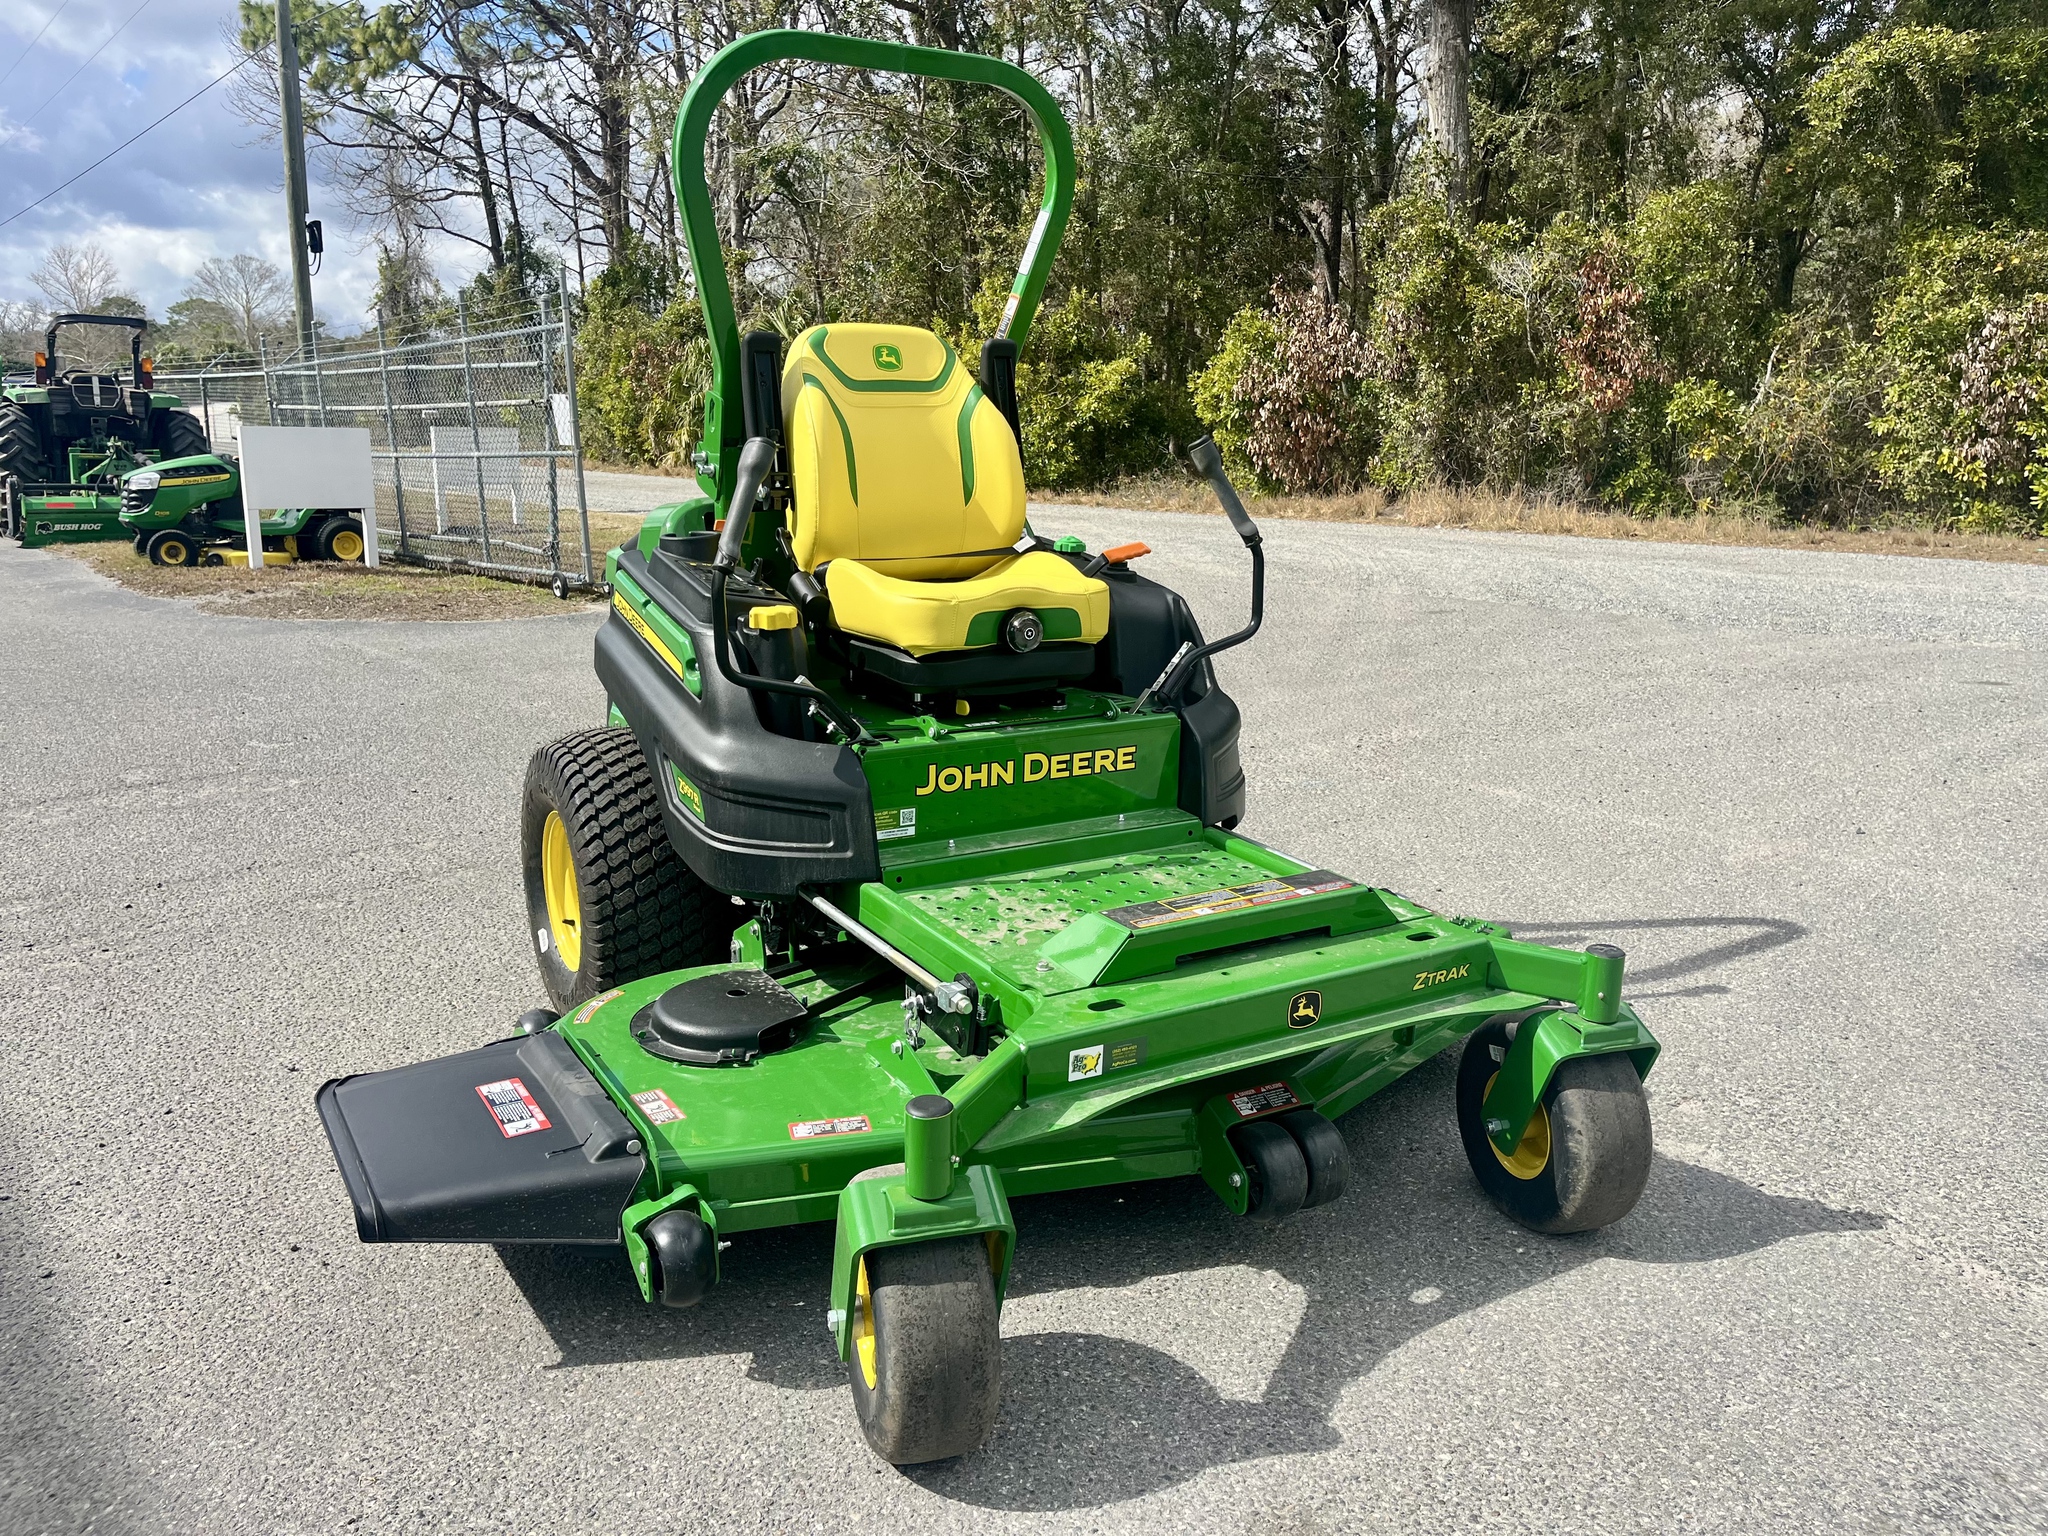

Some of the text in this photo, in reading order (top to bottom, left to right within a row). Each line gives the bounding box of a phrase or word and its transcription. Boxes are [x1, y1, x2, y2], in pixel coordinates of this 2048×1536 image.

[53, 523, 103, 531] BUSH HOG
[915, 745, 1137, 797] JOHN DEERE
[1412, 962, 1471, 991] ZTRAK
[1072, 1062, 1087, 1073] Pro
